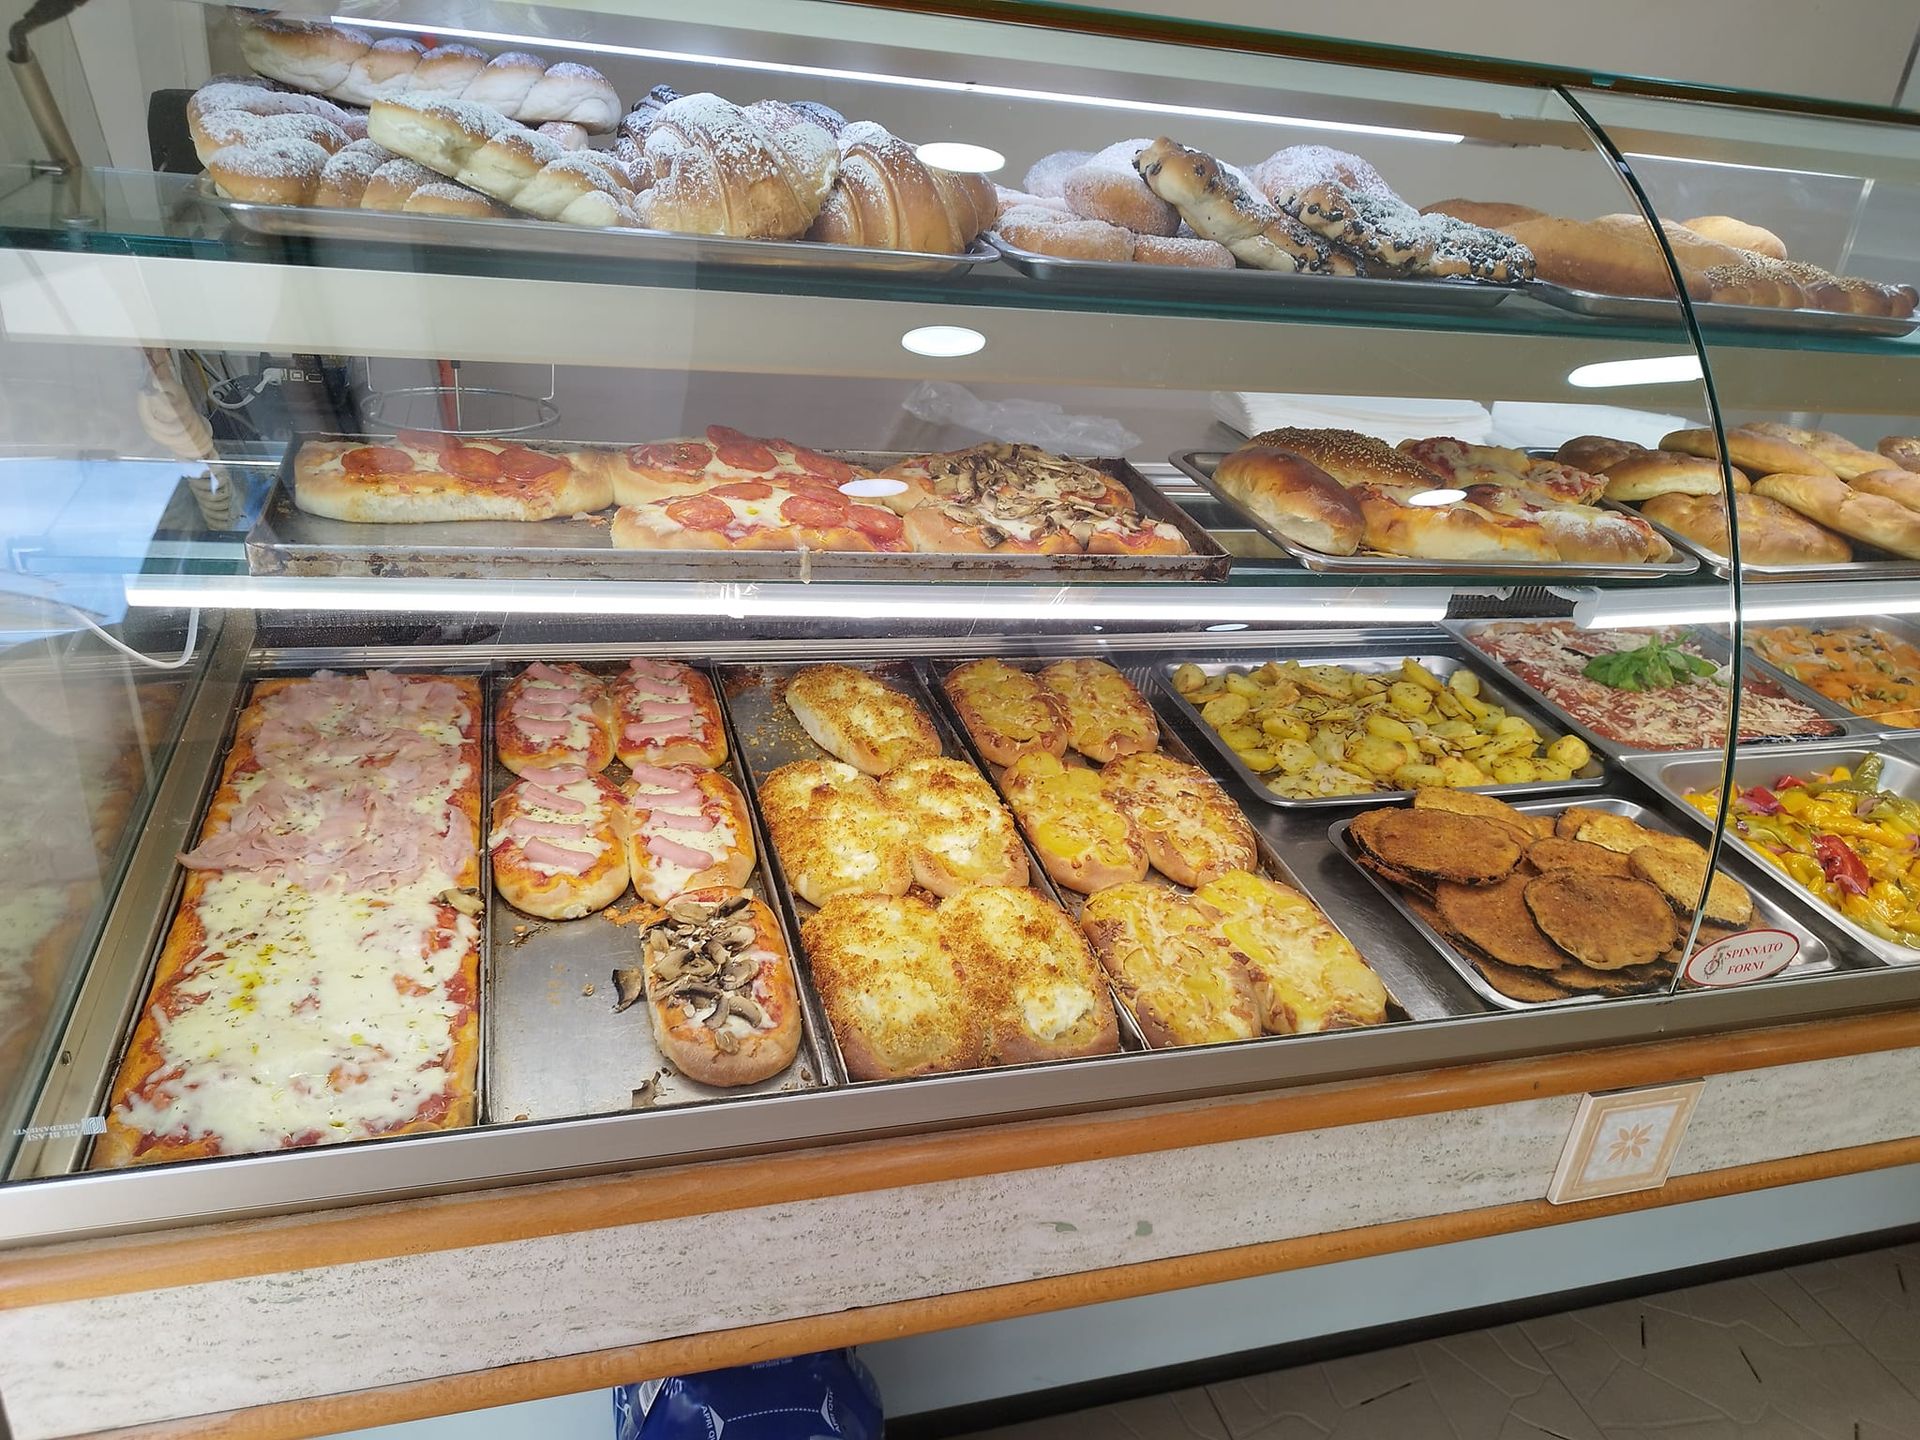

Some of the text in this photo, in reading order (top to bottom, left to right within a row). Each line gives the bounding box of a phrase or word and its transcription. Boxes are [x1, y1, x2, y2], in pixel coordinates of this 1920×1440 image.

[1724, 942, 1783, 960] SPINNATO
[1727, 961, 1765, 975] FORNI
[701, 1405, 713, 1429] APRI
